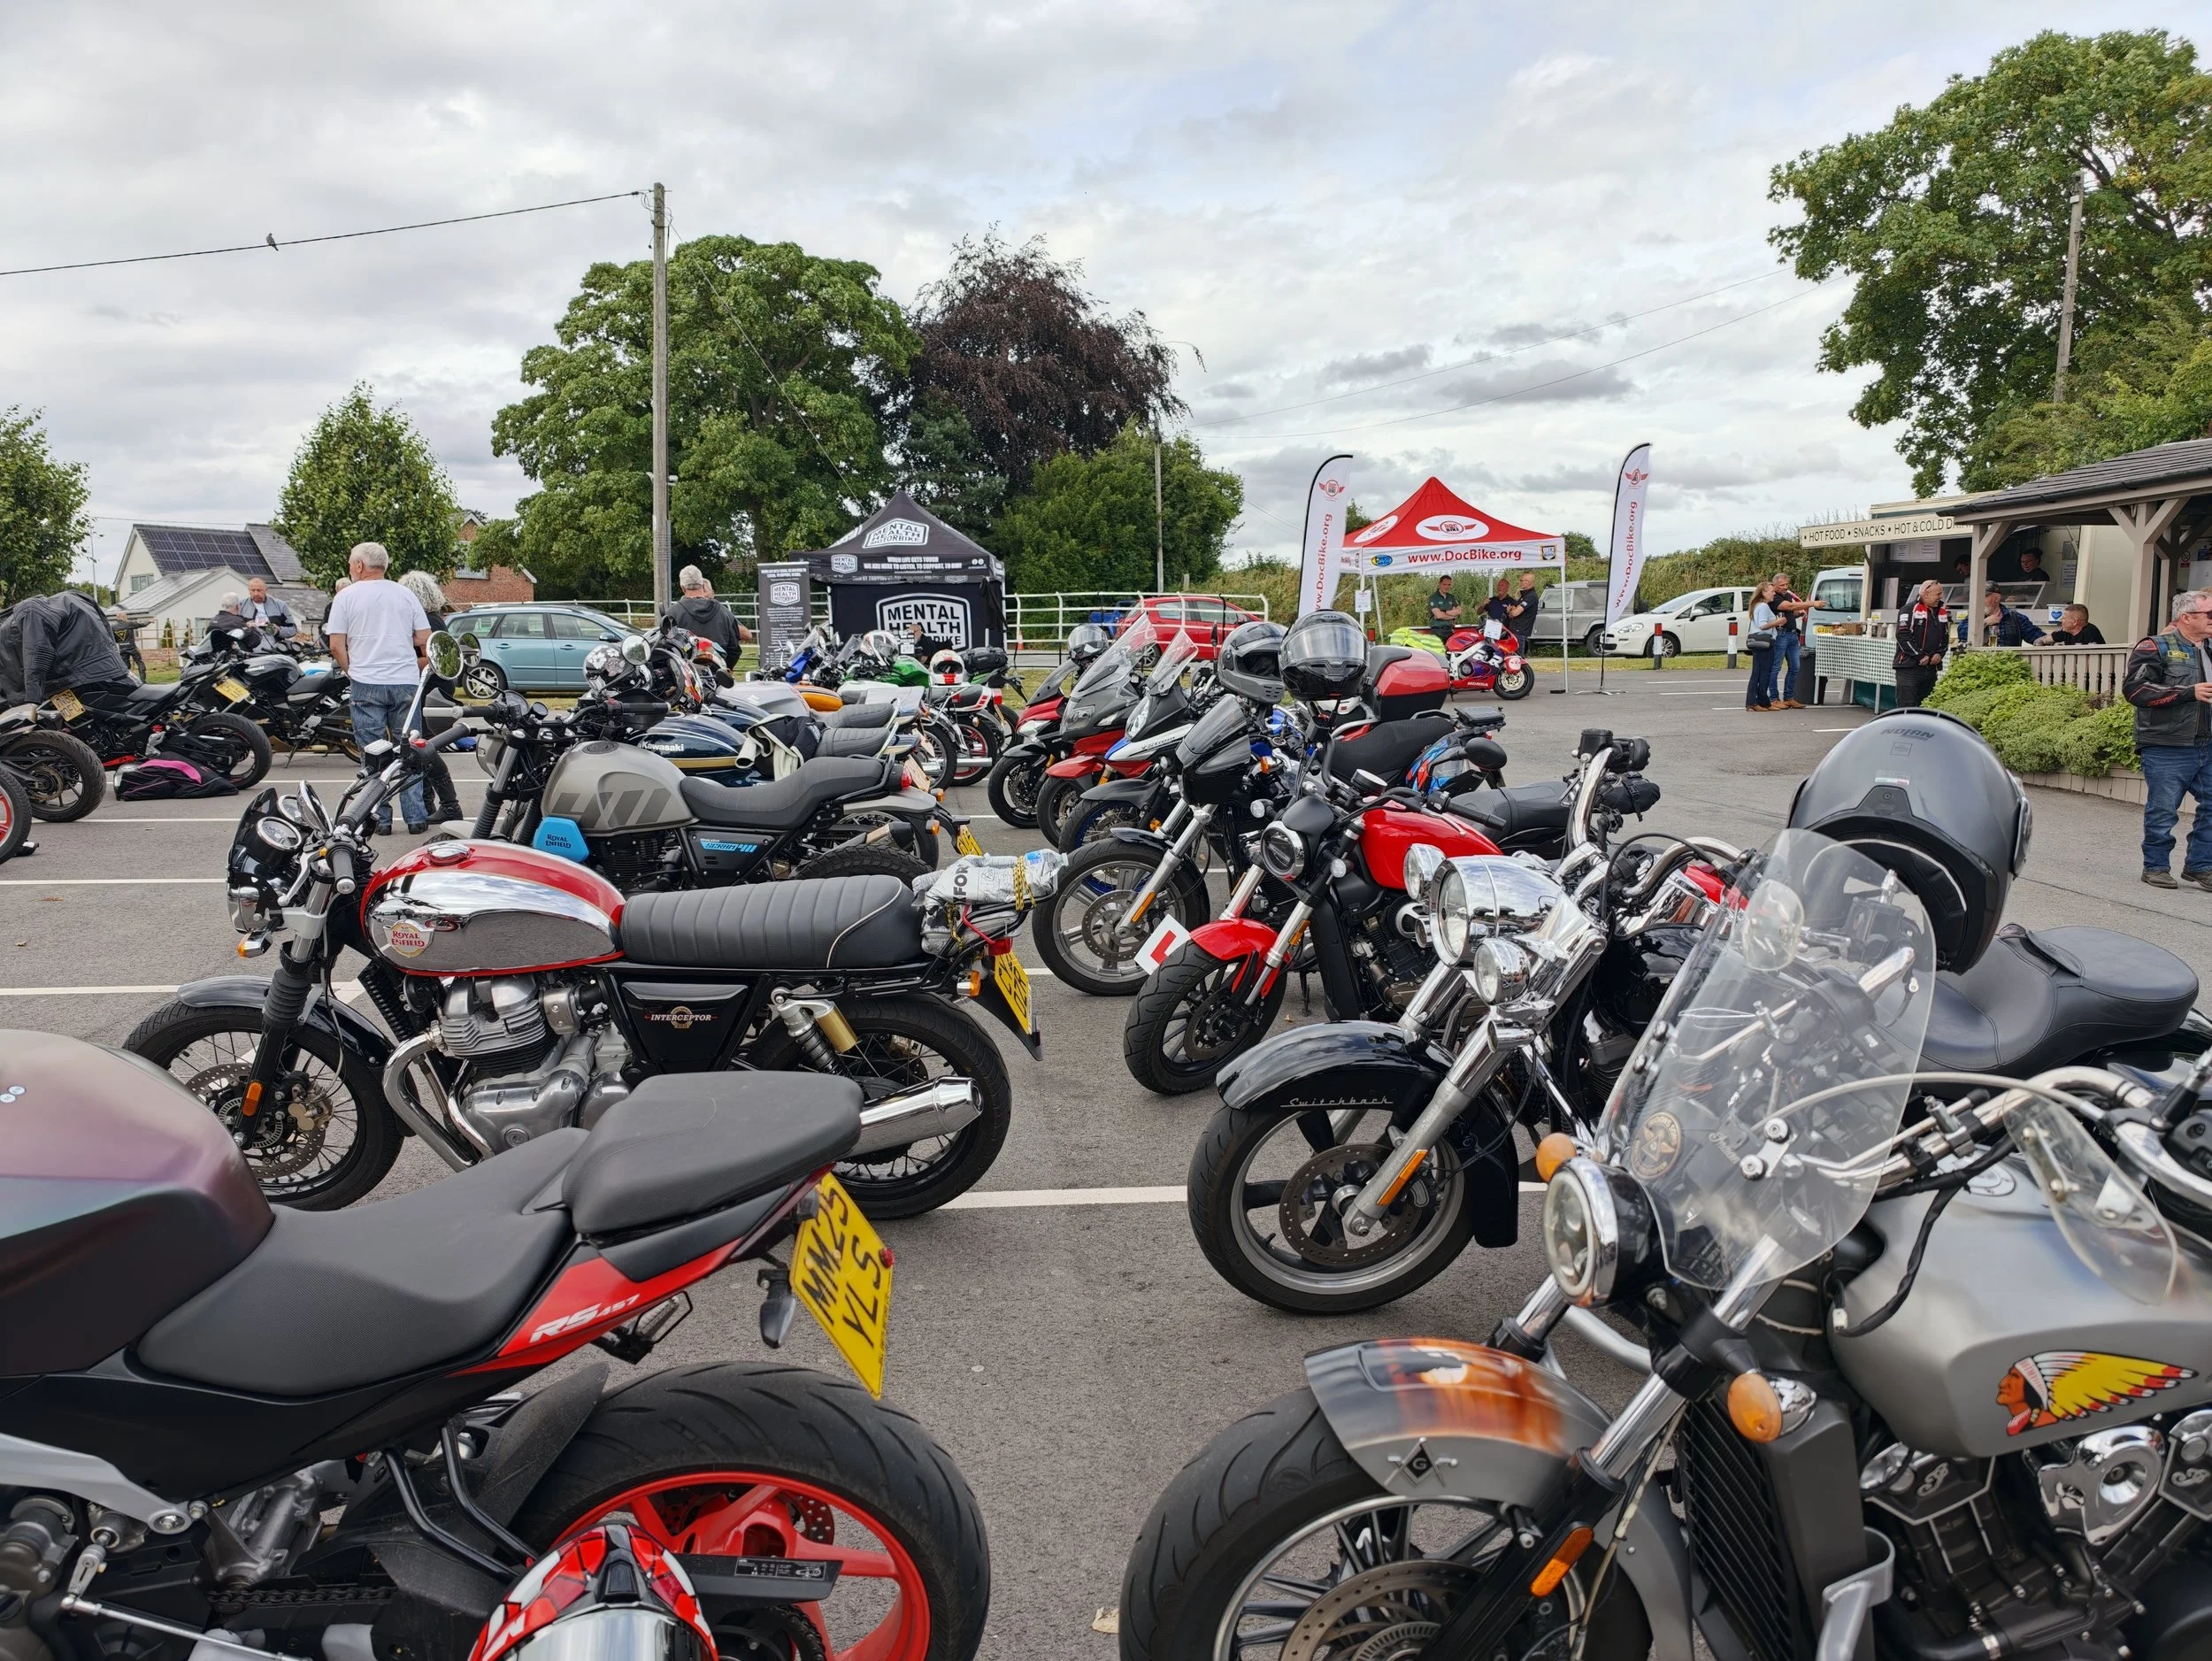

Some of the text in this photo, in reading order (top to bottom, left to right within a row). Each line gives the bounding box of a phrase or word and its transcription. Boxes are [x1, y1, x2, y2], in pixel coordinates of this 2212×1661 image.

[872, 530, 920, 541] HEALTH
[873, 523, 918, 536] MENTAL
[1809, 531, 1824, 542] HOT
[1825, 528, 1846, 541] FOOD
[1854, 525, 1886, 538] SNACKS
[1894, 522, 1911, 534] HOT
[1920, 519, 1944, 532] COLD
[871, 534, 918, 544] MOTORBIKE
[1408, 549, 1522, 564] www.DocBike.org
[1615, 501, 1638, 609] www.DocBike.org
[887, 604, 960, 620] MENTAL
[641, 740, 684, 752] Kawasaki
[545, 840, 572, 849] ENFIELD
[547, 834, 568, 842] ROYAL
[953, 864, 970, 904] XFOR
[392, 930, 420, 939] ROYAL
[391, 938, 425, 948] ENFIELD
[1150, 930, 1176, 965] L
[1288, 1096, 1391, 1107] Switchback
[801, 1187, 849, 1326] MM25
[841, 1234, 882, 1349] YLS
[529, 1293, 641, 1343] RS 457
